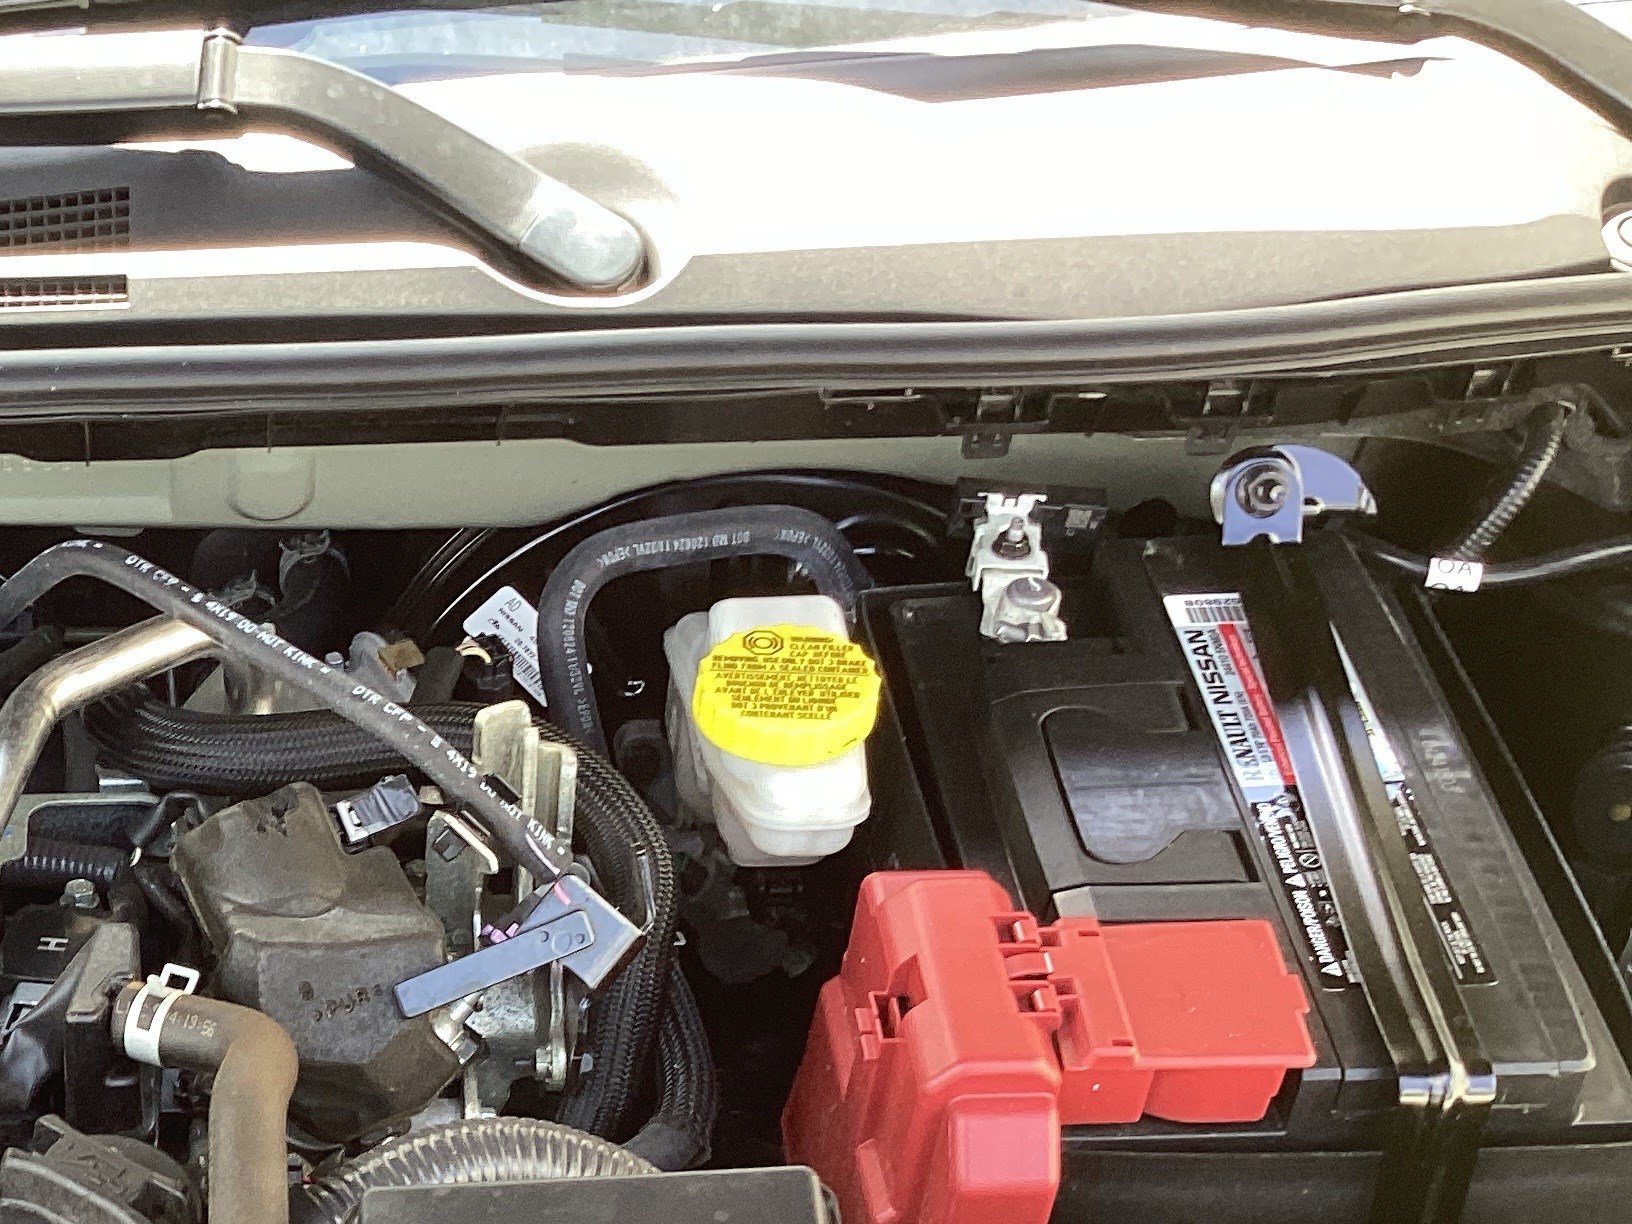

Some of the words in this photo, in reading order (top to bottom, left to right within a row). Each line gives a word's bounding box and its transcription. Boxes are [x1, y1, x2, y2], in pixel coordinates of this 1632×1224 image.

[1184, 630, 1234, 706] NISSAN
[1217, 711, 1265, 781] RENAULT
[526, 817, 556, 850] KINK
